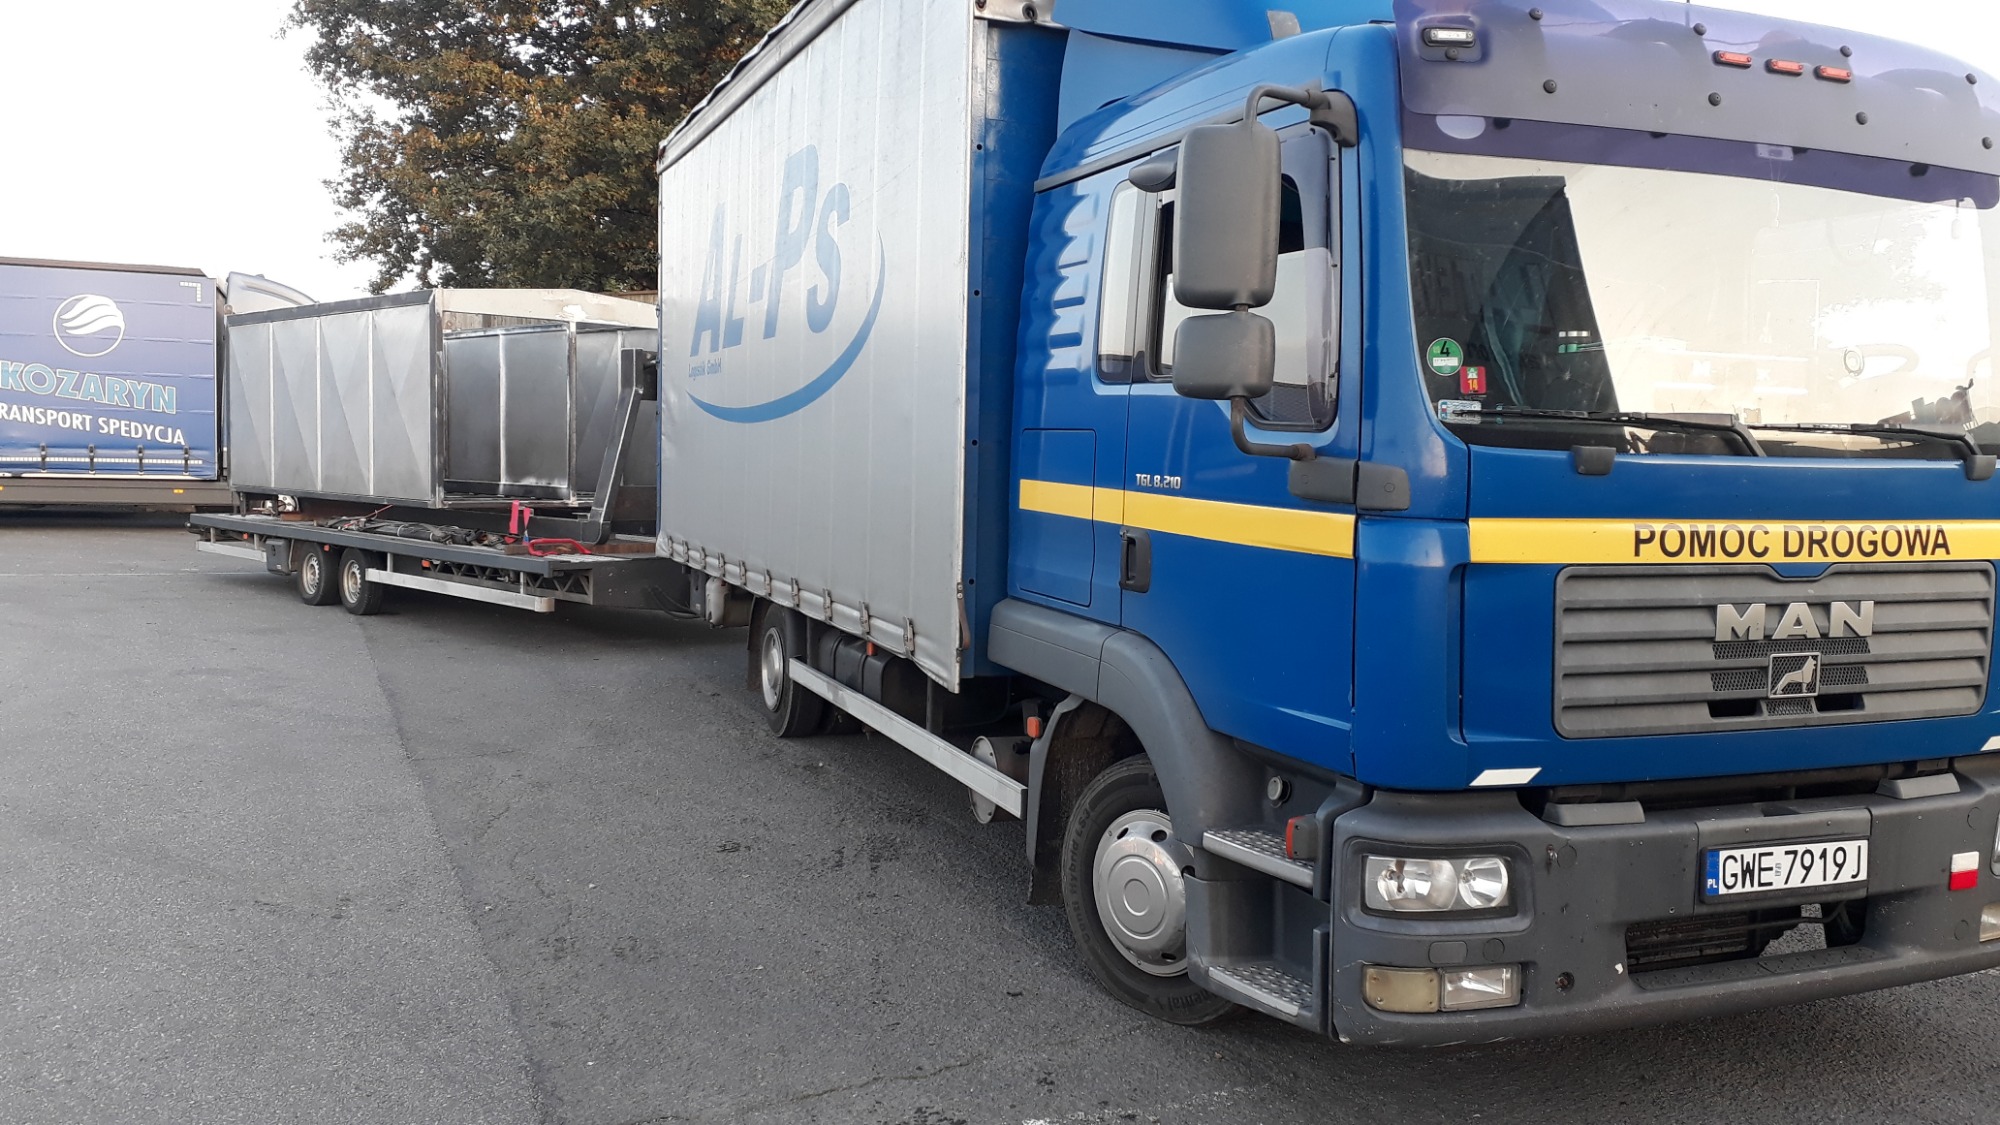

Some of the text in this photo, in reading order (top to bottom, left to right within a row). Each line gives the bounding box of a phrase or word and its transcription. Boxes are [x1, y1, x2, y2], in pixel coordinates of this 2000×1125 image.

[1440, 341, 1450, 357] 4
[0, 360, 177, 415] KOZARYN
[0, 402, 185, 446] RANSPORT SPEDYCJA
[1136, 473, 1181, 489] TGL 8.210
[1633, 523, 1951, 558] POMOC DROGOWA
[1715, 600, 1875, 641] MAN
[1707, 845, 1862, 890] PL GWE 7919J
